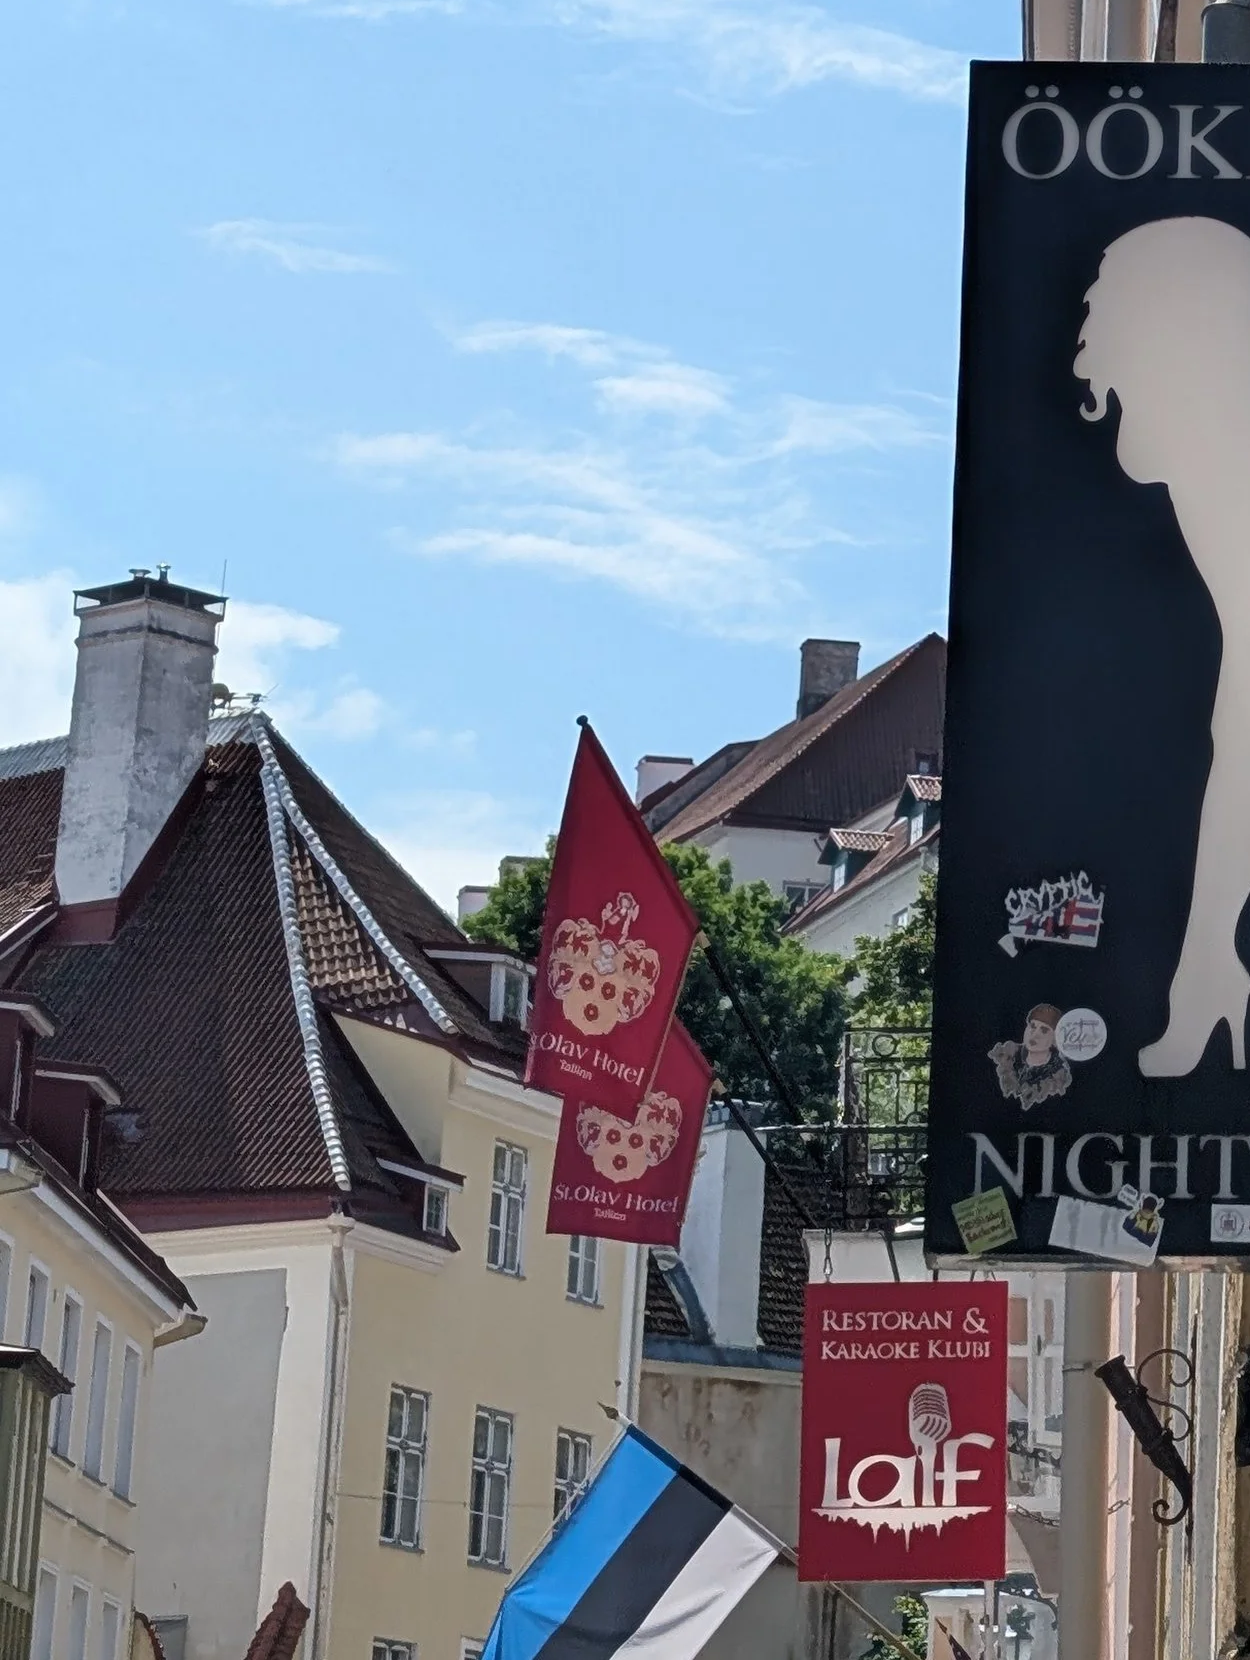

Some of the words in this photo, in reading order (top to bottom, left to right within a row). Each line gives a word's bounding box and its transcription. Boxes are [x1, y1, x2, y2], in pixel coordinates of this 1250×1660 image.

[1004, 870, 1101, 918] CRYPTIC
[560, 1058, 593, 1081] Tallinn
[593, 1049, 645, 1086] Hotel
[625, 1193, 679, 1213] Hotel
[822, 1309, 952, 1331] RESTORAN
[962, 1307, 989, 1334] &
[821, 1341, 920, 1360] KARAOKE
[928, 1340, 990, 1358] KLUBI
